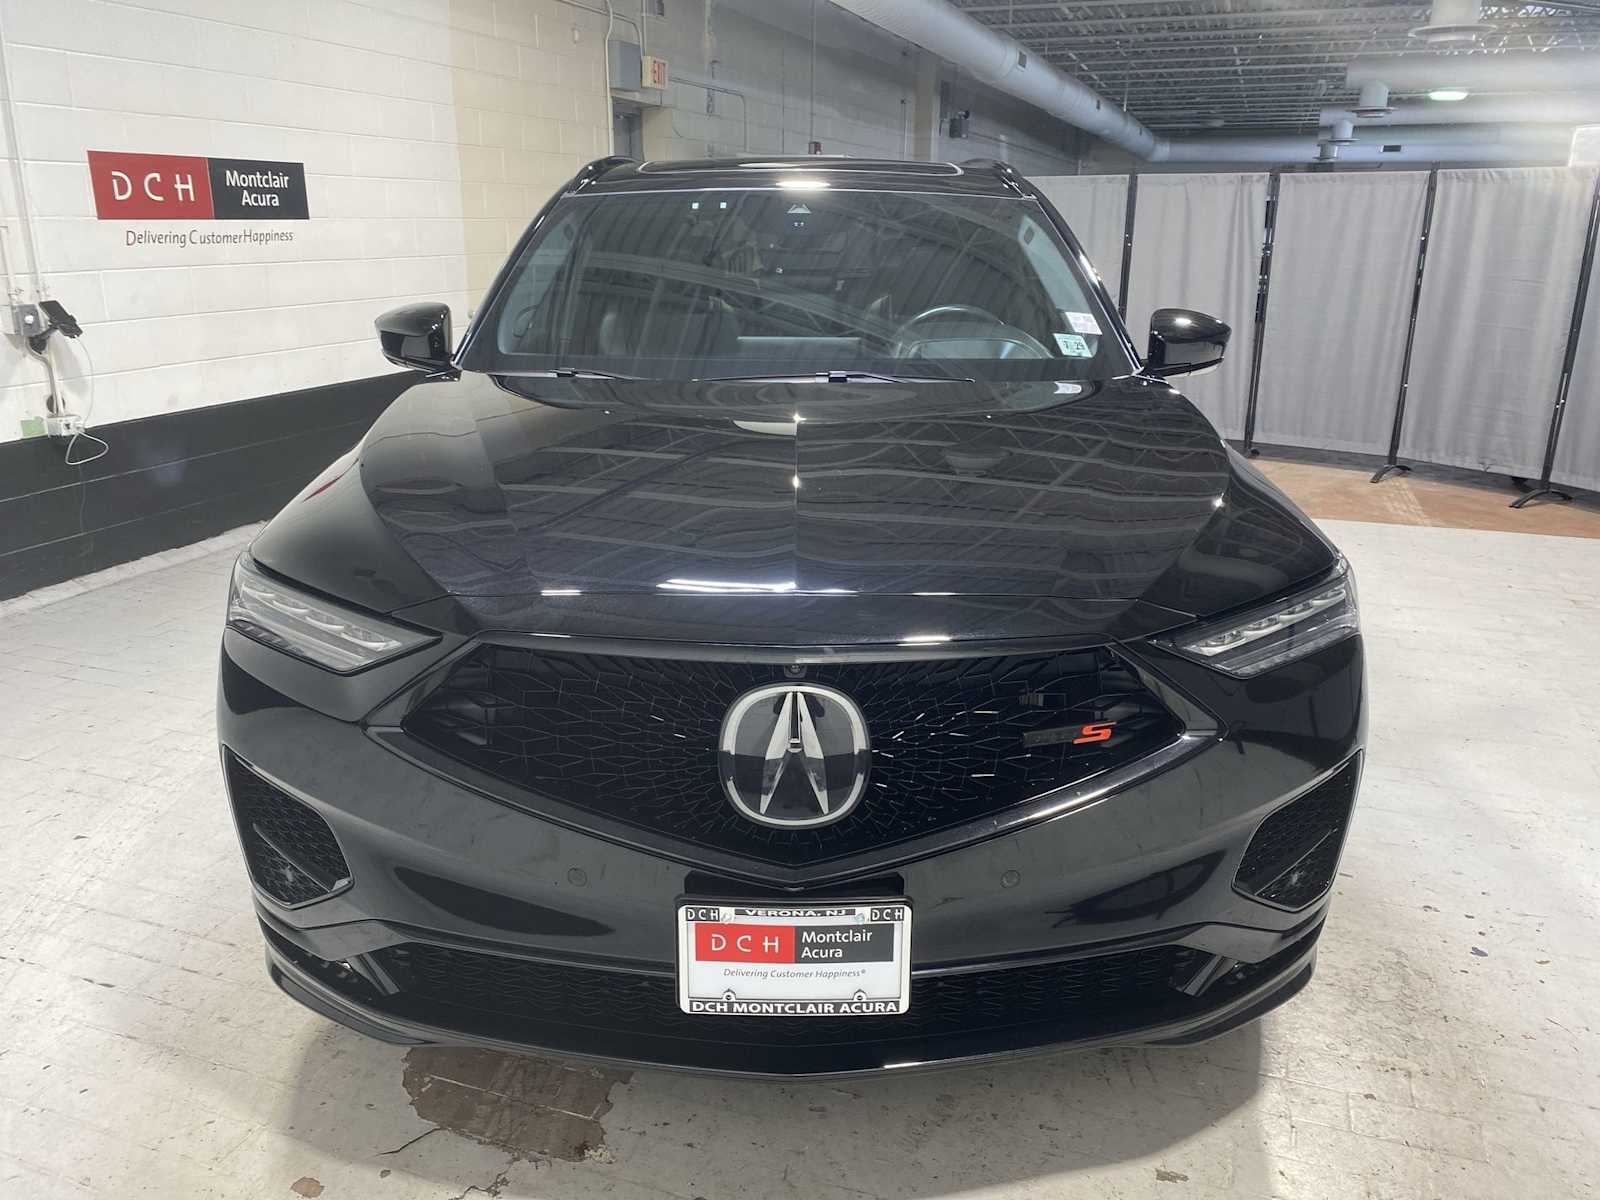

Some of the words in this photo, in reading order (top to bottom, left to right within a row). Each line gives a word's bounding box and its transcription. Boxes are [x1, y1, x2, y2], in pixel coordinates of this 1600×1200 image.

[111, 170, 196, 202] DCH
[225, 169, 290, 189] Montclair
[241, 189, 280, 207] Acura
[125, 230, 187, 248] Delivering
[1072, 721, 1118, 744] S
[687, 908, 719, 920] DCH
[871, 908, 904, 921] DCH
[711, 933, 779, 953] DCH
[801, 929, 873, 943] Montclair
[801, 946, 843, 959] Acura
[723, 968, 769, 980] Delivering
[770, 969, 813, 978] Customer
[692, 1001, 729, 1012] DCH
[732, 1002, 835, 1014] MONTCLAIR
[839, 1001, 898, 1013] ACURA
